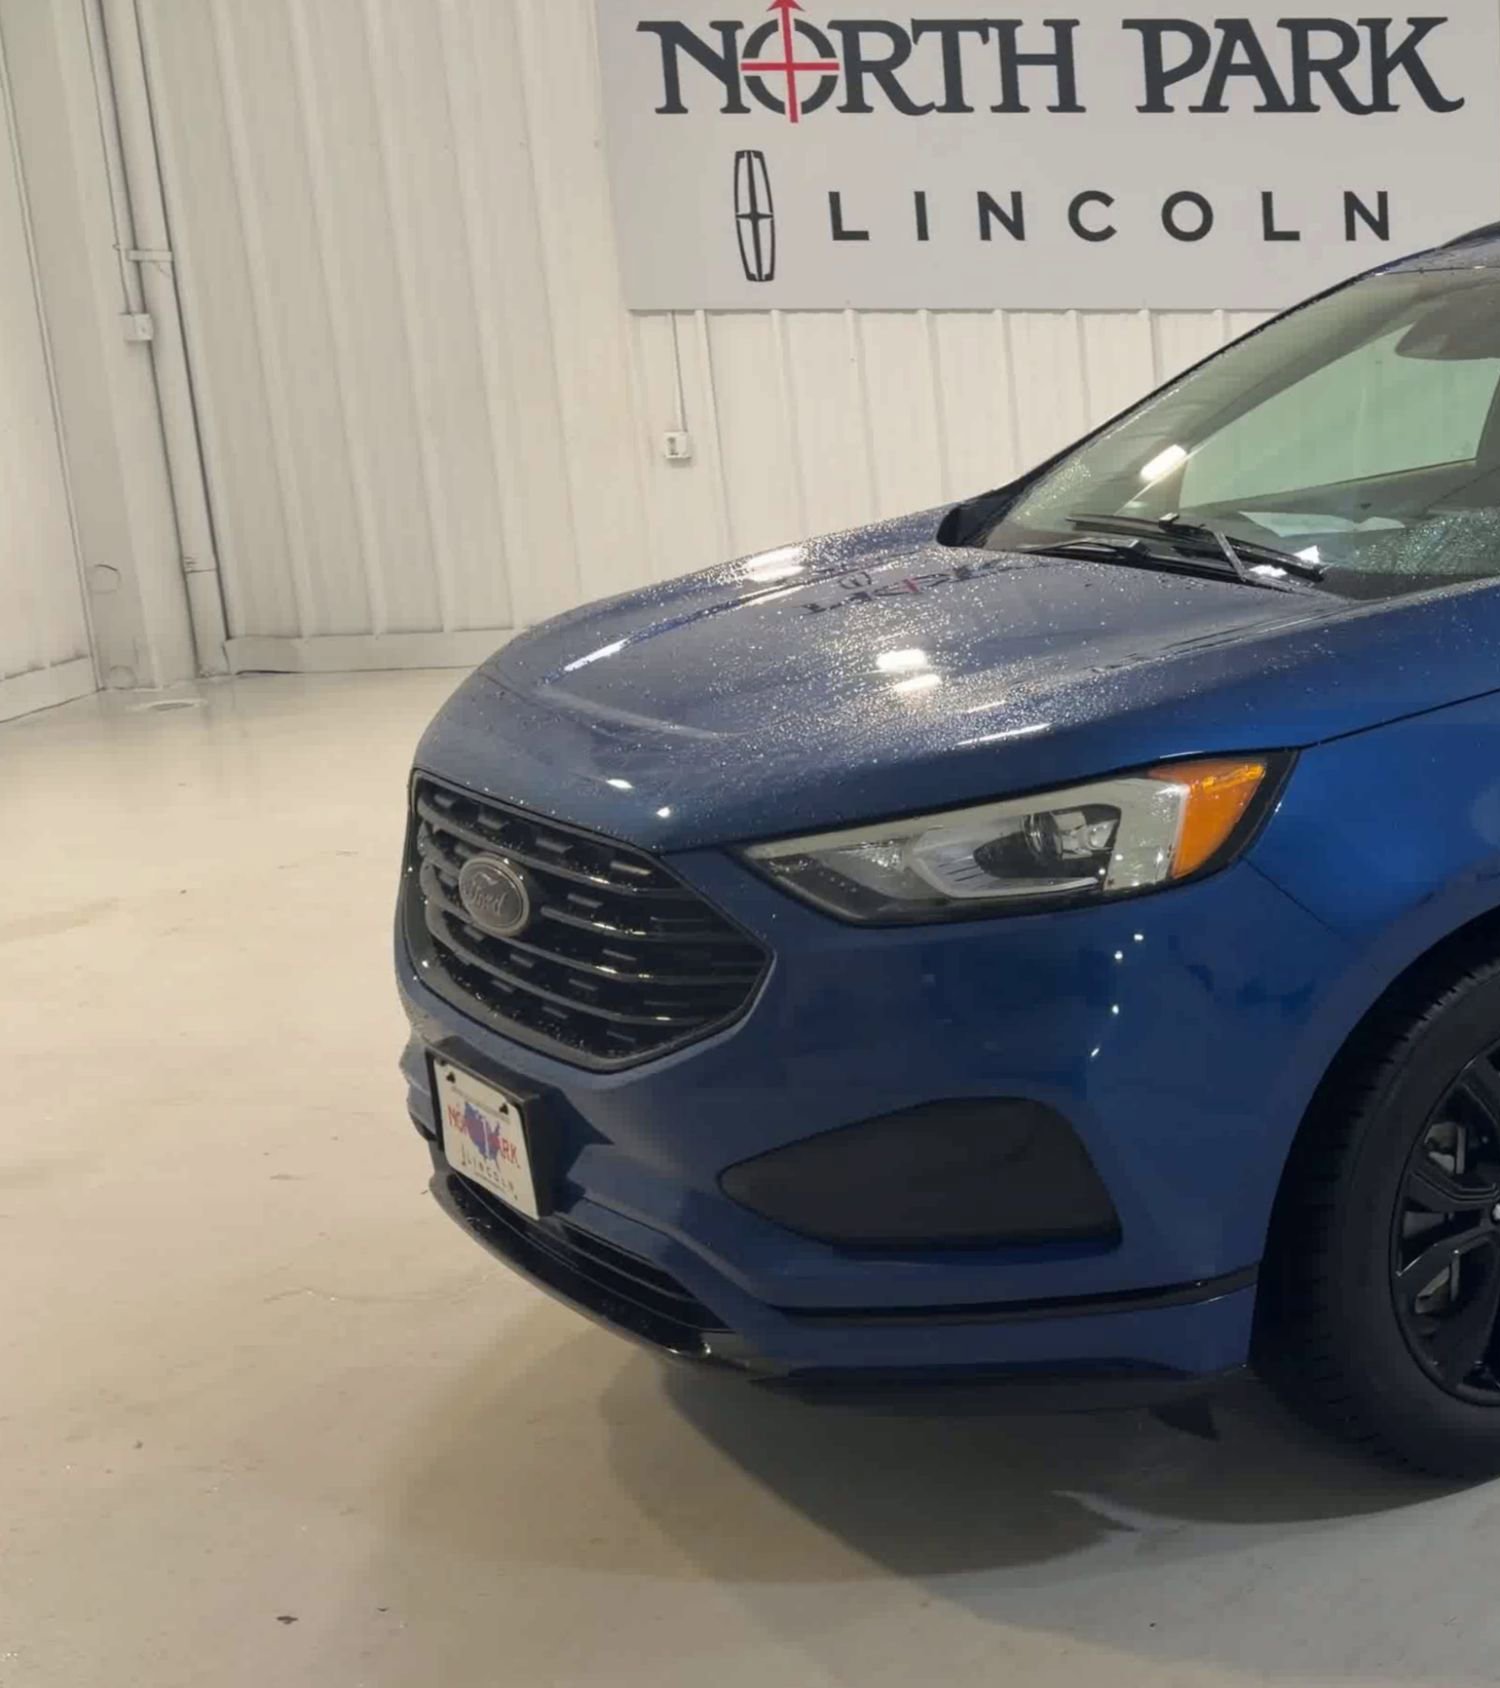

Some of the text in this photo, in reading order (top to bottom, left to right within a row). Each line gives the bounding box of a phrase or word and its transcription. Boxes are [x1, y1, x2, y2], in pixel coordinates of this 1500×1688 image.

[636, 16, 1465, 116] NORTH PARK
[828, 190, 1390, 242] LINCOLN
